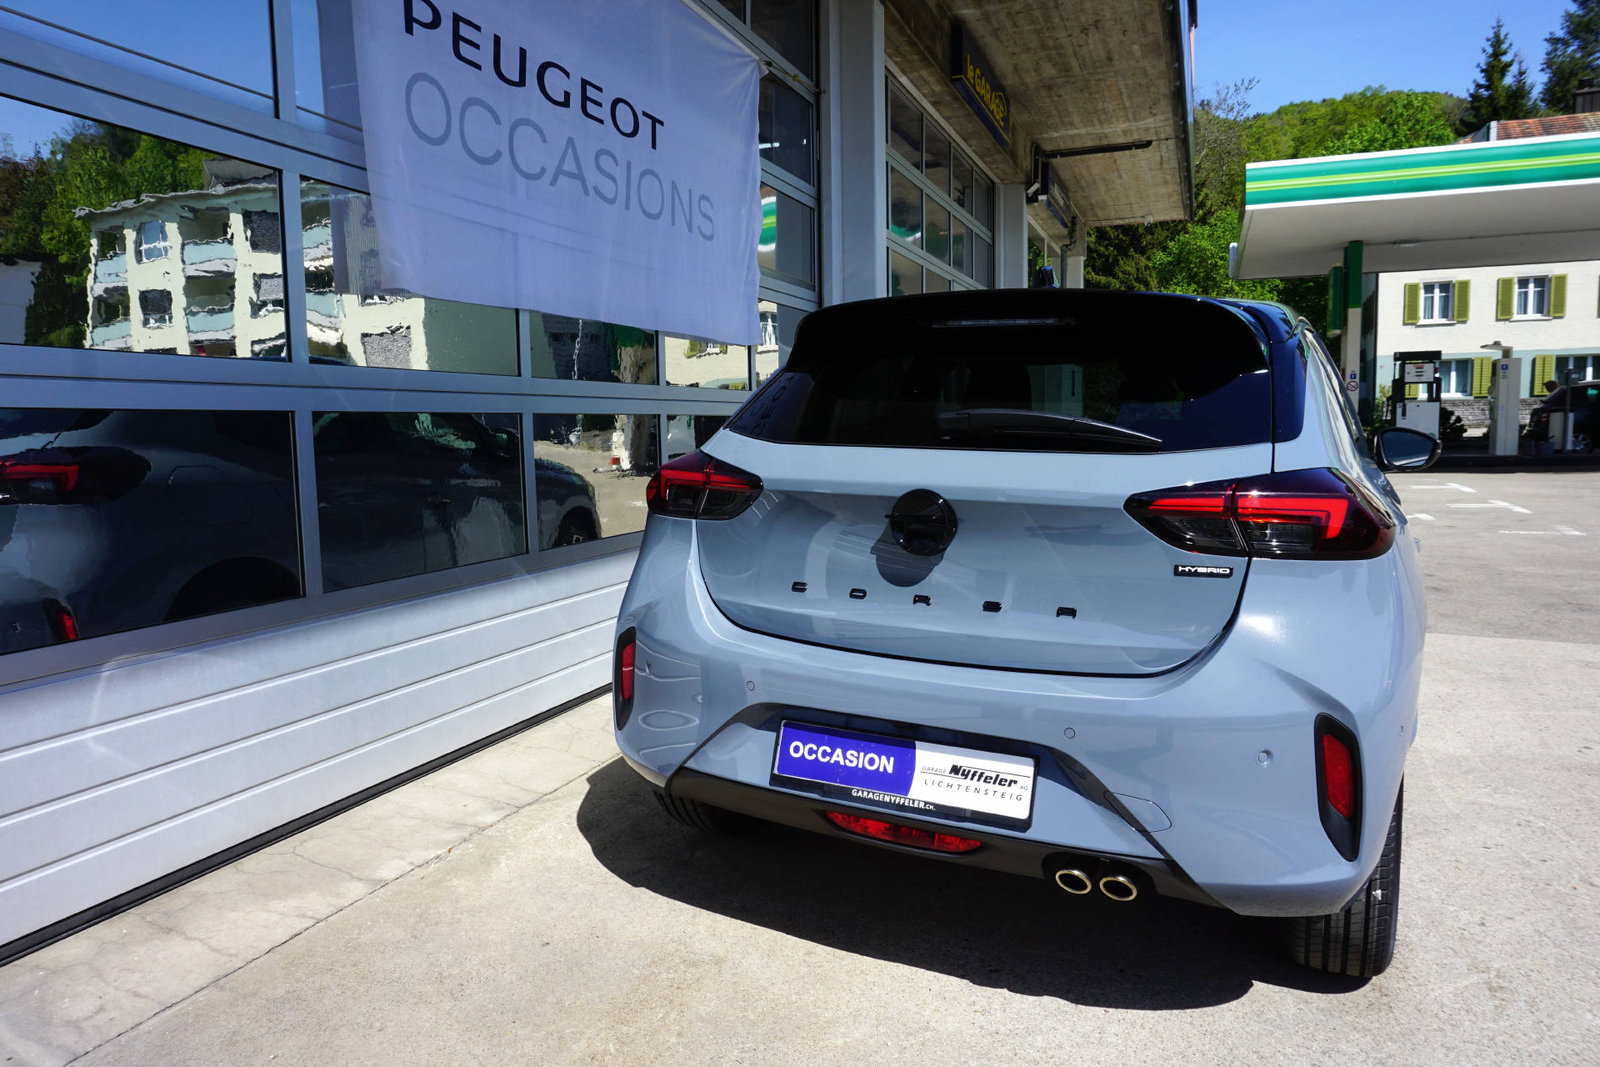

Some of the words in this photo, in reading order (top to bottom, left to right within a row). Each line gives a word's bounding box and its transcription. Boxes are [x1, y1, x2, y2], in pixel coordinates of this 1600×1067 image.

[403, 0, 665, 151] PEUGEOT
[966, 53, 974, 84] le
[974, 67, 1005, 128] GARAGE
[404, 71, 716, 242] OCCASIONS
[1178, 565, 1231, 575] HYBRID
[791, 581, 1078, 620] CORSA
[789, 740, 895, 775] OCCASION
[921, 765, 947, 775] GARAGE
[948, 763, 1018, 789] Nyffeler
[923, 778, 1024, 802] LICHTENSTEIG
